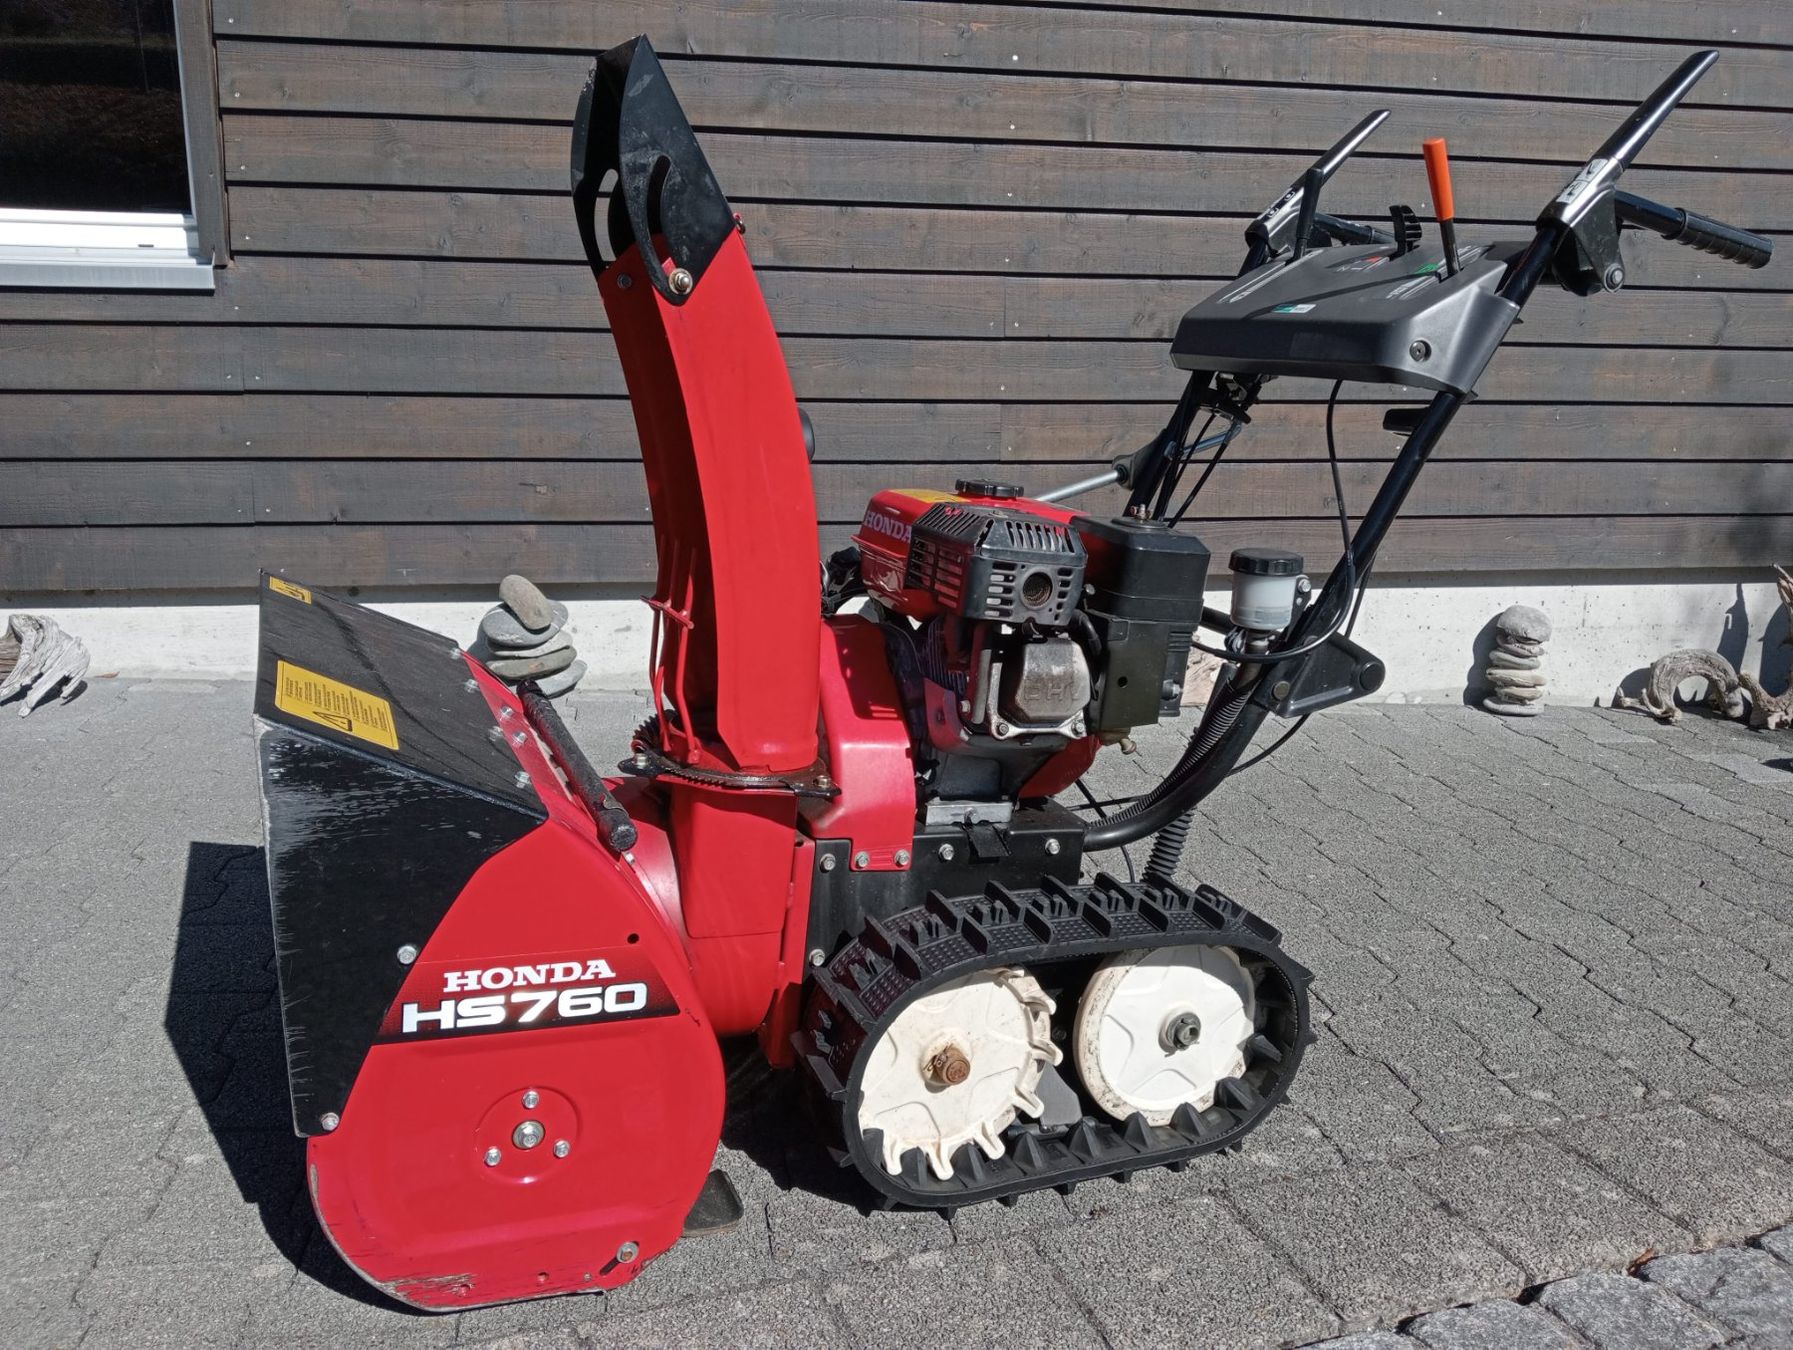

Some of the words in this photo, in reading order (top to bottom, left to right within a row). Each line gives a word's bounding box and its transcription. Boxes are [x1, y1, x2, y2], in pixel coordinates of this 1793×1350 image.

[864, 511, 912, 544] HONDA
[443, 959, 616, 992] HONDA
[402, 982, 648, 1033] HS760
